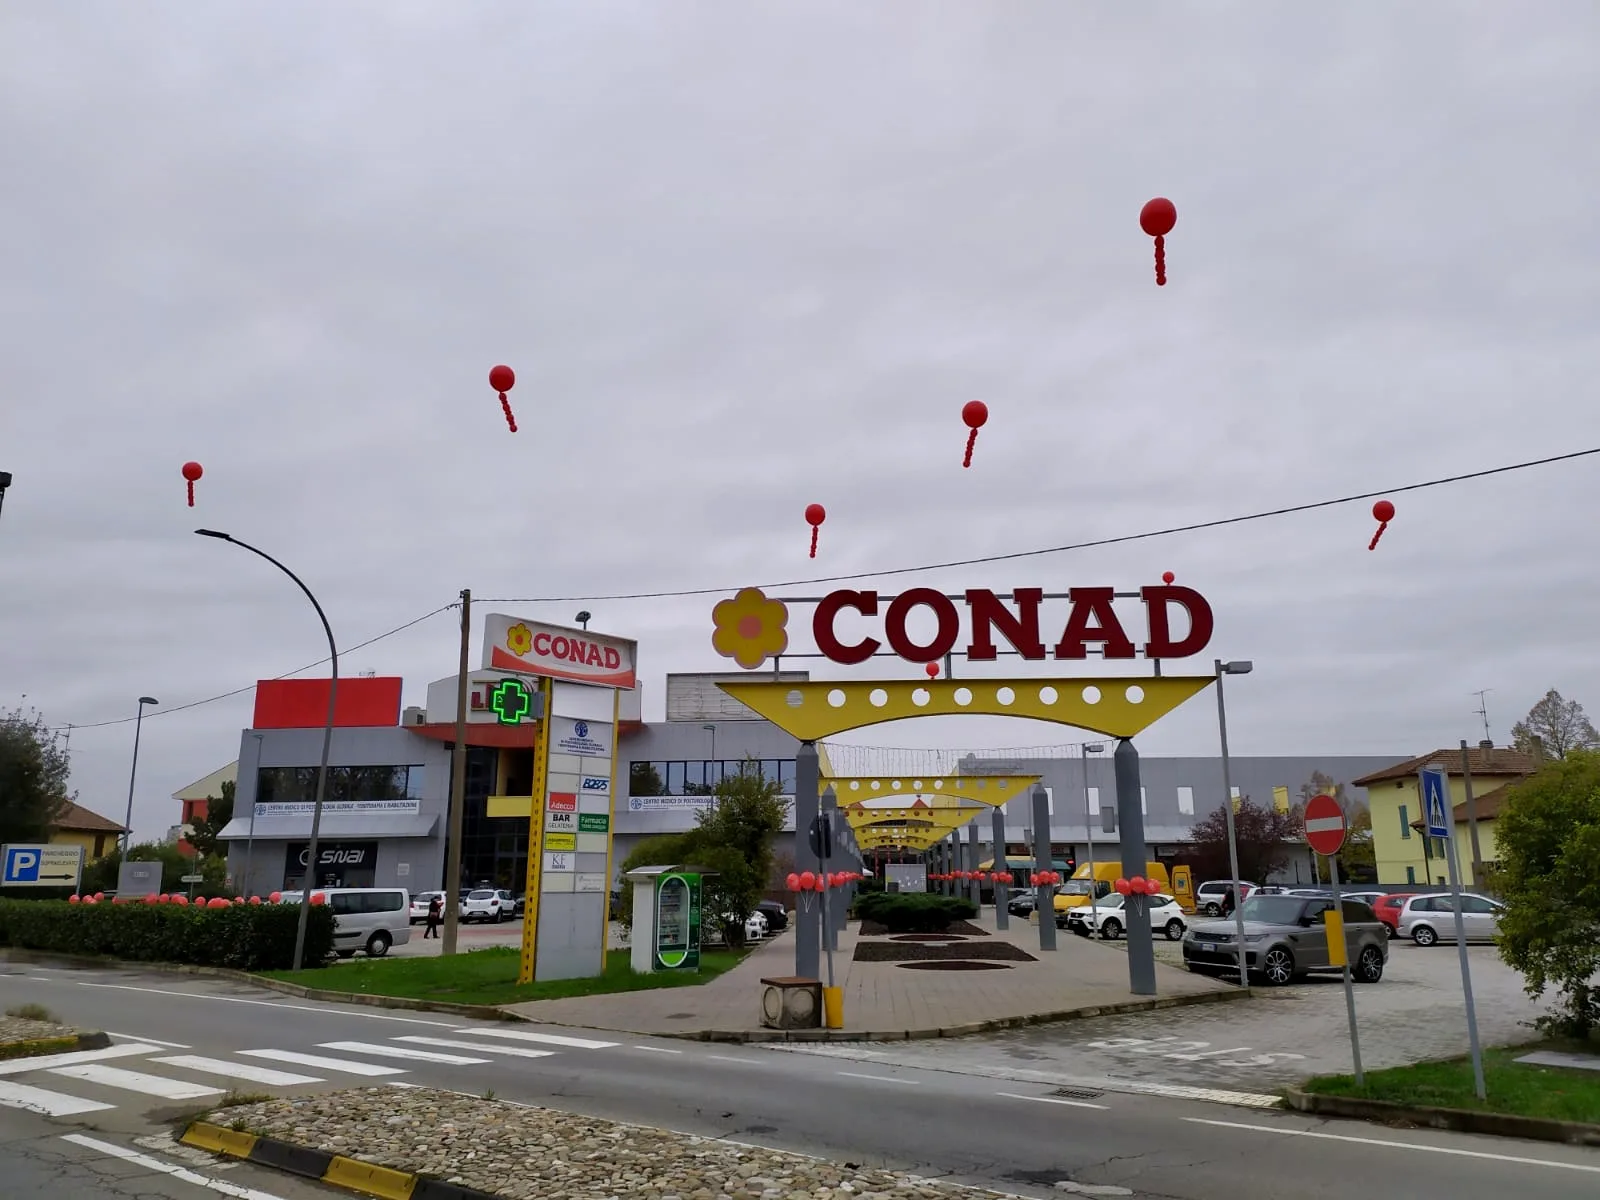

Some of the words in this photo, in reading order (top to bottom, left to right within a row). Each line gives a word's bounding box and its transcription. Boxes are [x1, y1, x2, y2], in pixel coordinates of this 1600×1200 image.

[812, 585, 1213, 665] CONAD
[533, 632, 621, 669] CONAD
[551, 801, 574, 810] Adecco
[553, 814, 570, 822] BAR
[12, 852, 36, 878] P
